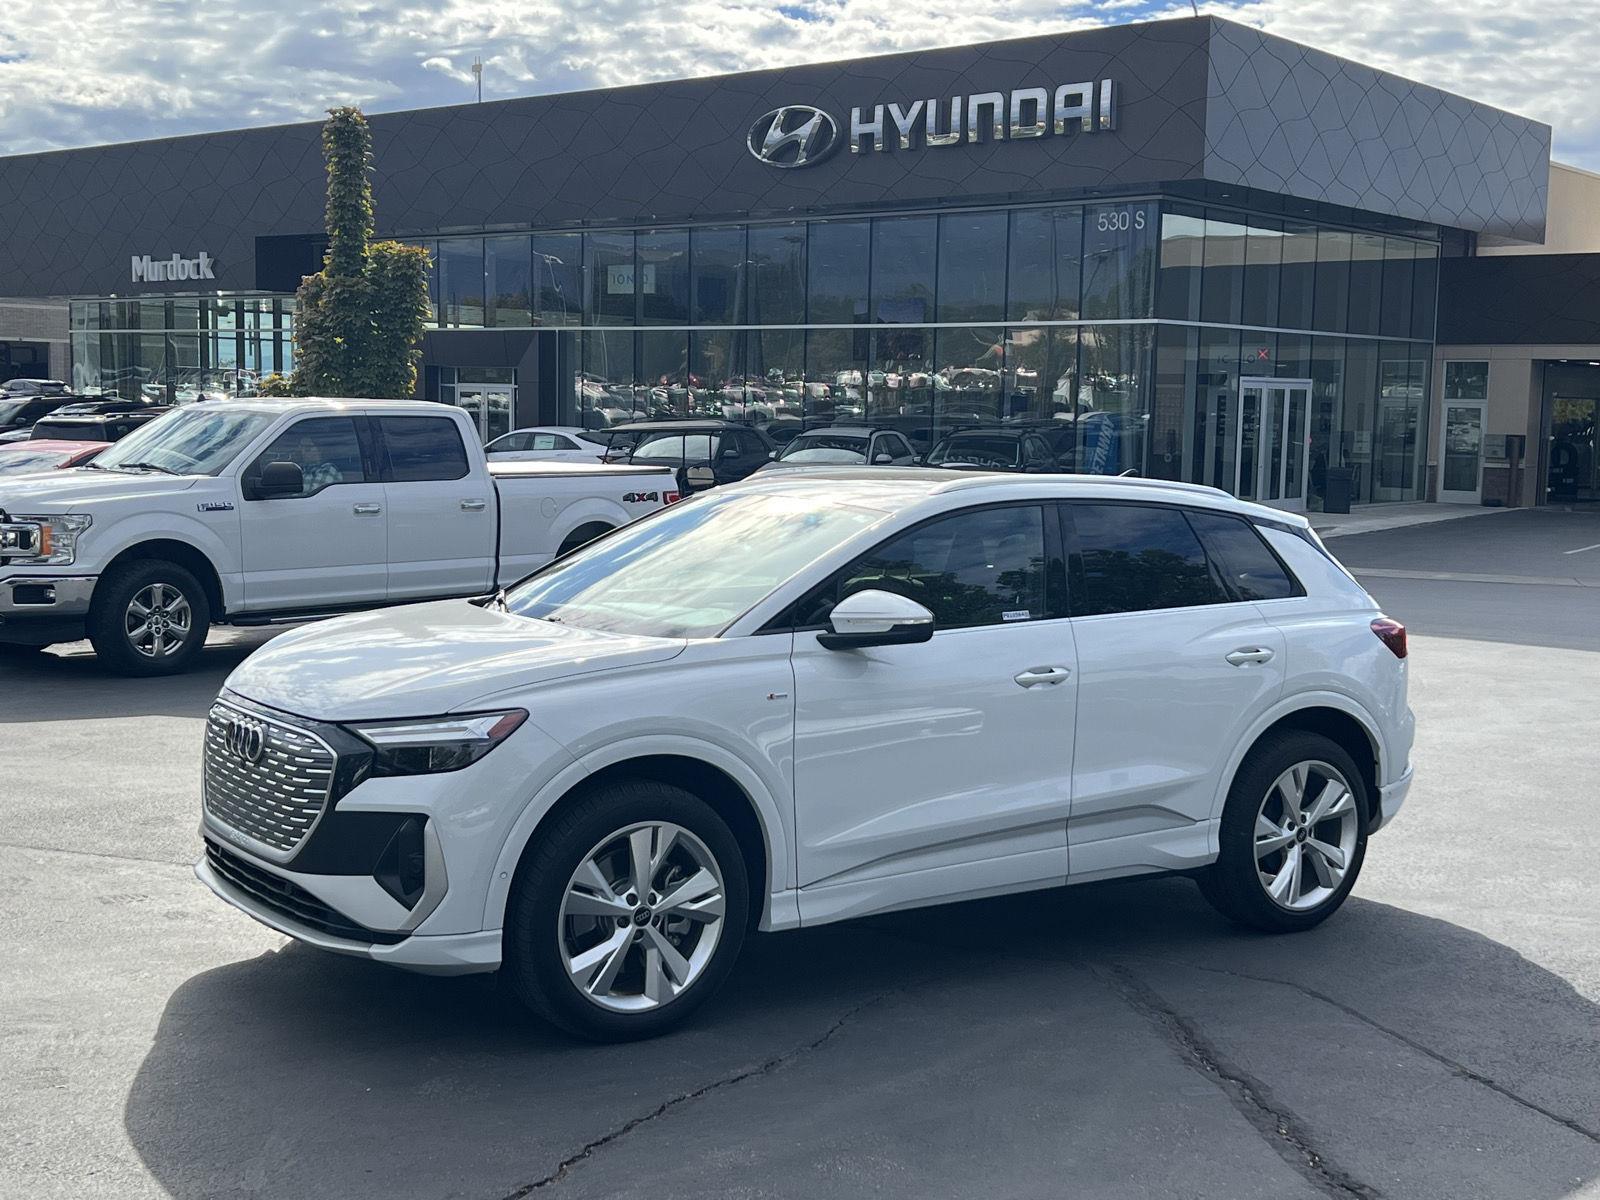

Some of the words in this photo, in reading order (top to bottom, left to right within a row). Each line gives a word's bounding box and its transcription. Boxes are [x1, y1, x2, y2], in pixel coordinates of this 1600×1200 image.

[851, 79, 1114, 152] HYUNDAI
[1097, 212, 1129, 231] 530
[1134, 210, 1145, 229] S
[131, 251, 215, 282] Murdock
[1090, 415, 1115, 474] ETAWAY
